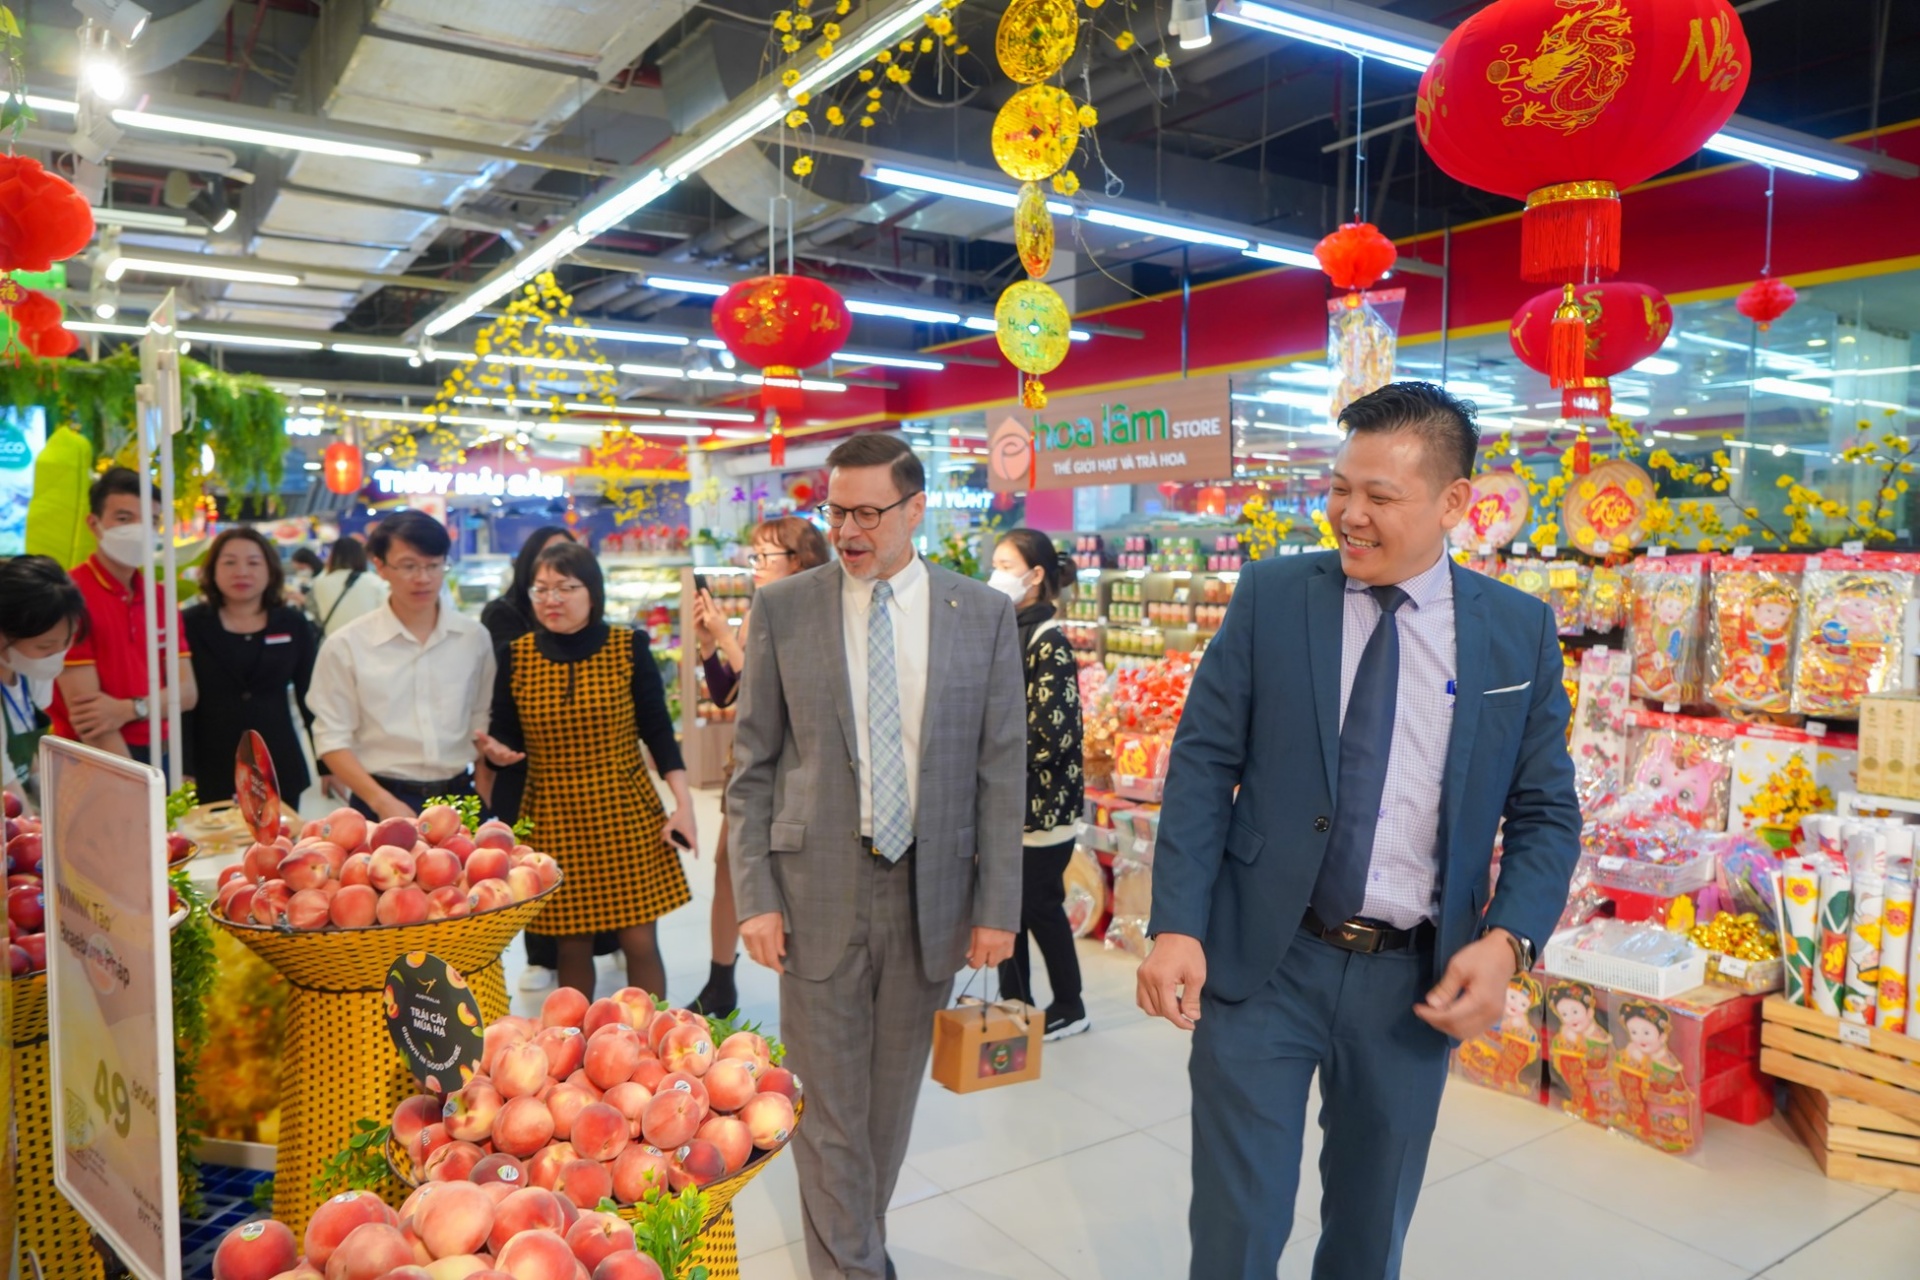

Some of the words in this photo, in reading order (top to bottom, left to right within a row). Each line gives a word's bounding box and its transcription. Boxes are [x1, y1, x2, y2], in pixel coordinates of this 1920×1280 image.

[1033, 413, 1094, 452] hoa
[1101, 404, 1169, 445] lâm
[1172, 418, 1221, 439] STORE
[1053, 460, 1073, 475] THẾ
[1074, 457, 1095, 474] GIỚI
[1098, 458, 1118, 474] HẠT
[1120, 453, 1134, 470] VÀ
[1136, 453, 1158, 469] TRÀ
[1160, 451, 1187, 467] HOA
[455, 466, 504, 496] HẢI
[415, 993, 440, 1004] AUSTRALIA
[409, 1006, 429, 1021] TRÁI
[430, 1012, 449, 1026] CÂY
[433, 1025, 446, 1038] HẠ
[401, 1025, 418, 1058] GROWN
[419, 1054, 426, 1065] IN
[426, 1061, 445, 1071] GOOD
[444, 1044, 462, 1069] NATURE
[94, 1059, 131, 1140] 49
